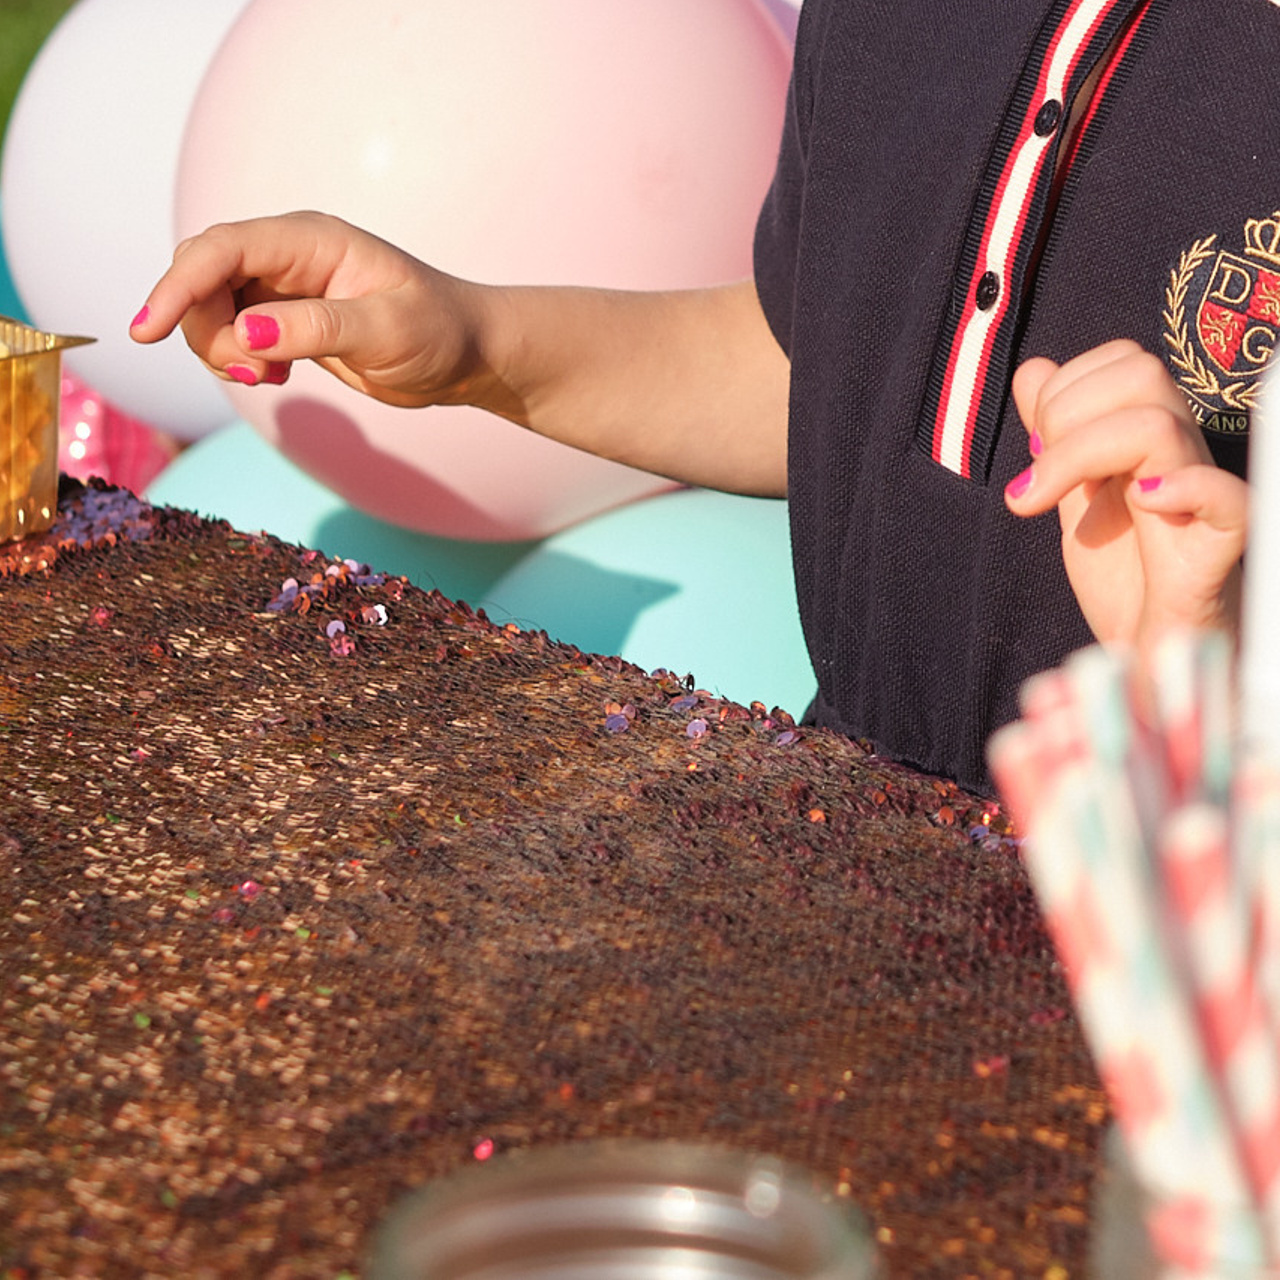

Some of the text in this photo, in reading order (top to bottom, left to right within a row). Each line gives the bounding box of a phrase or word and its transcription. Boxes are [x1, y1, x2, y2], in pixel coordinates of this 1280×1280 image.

[1210, 262, 1251, 304] D
[1242, 326, 1275, 363] G
[1186, 399, 1248, 431] ILANO
